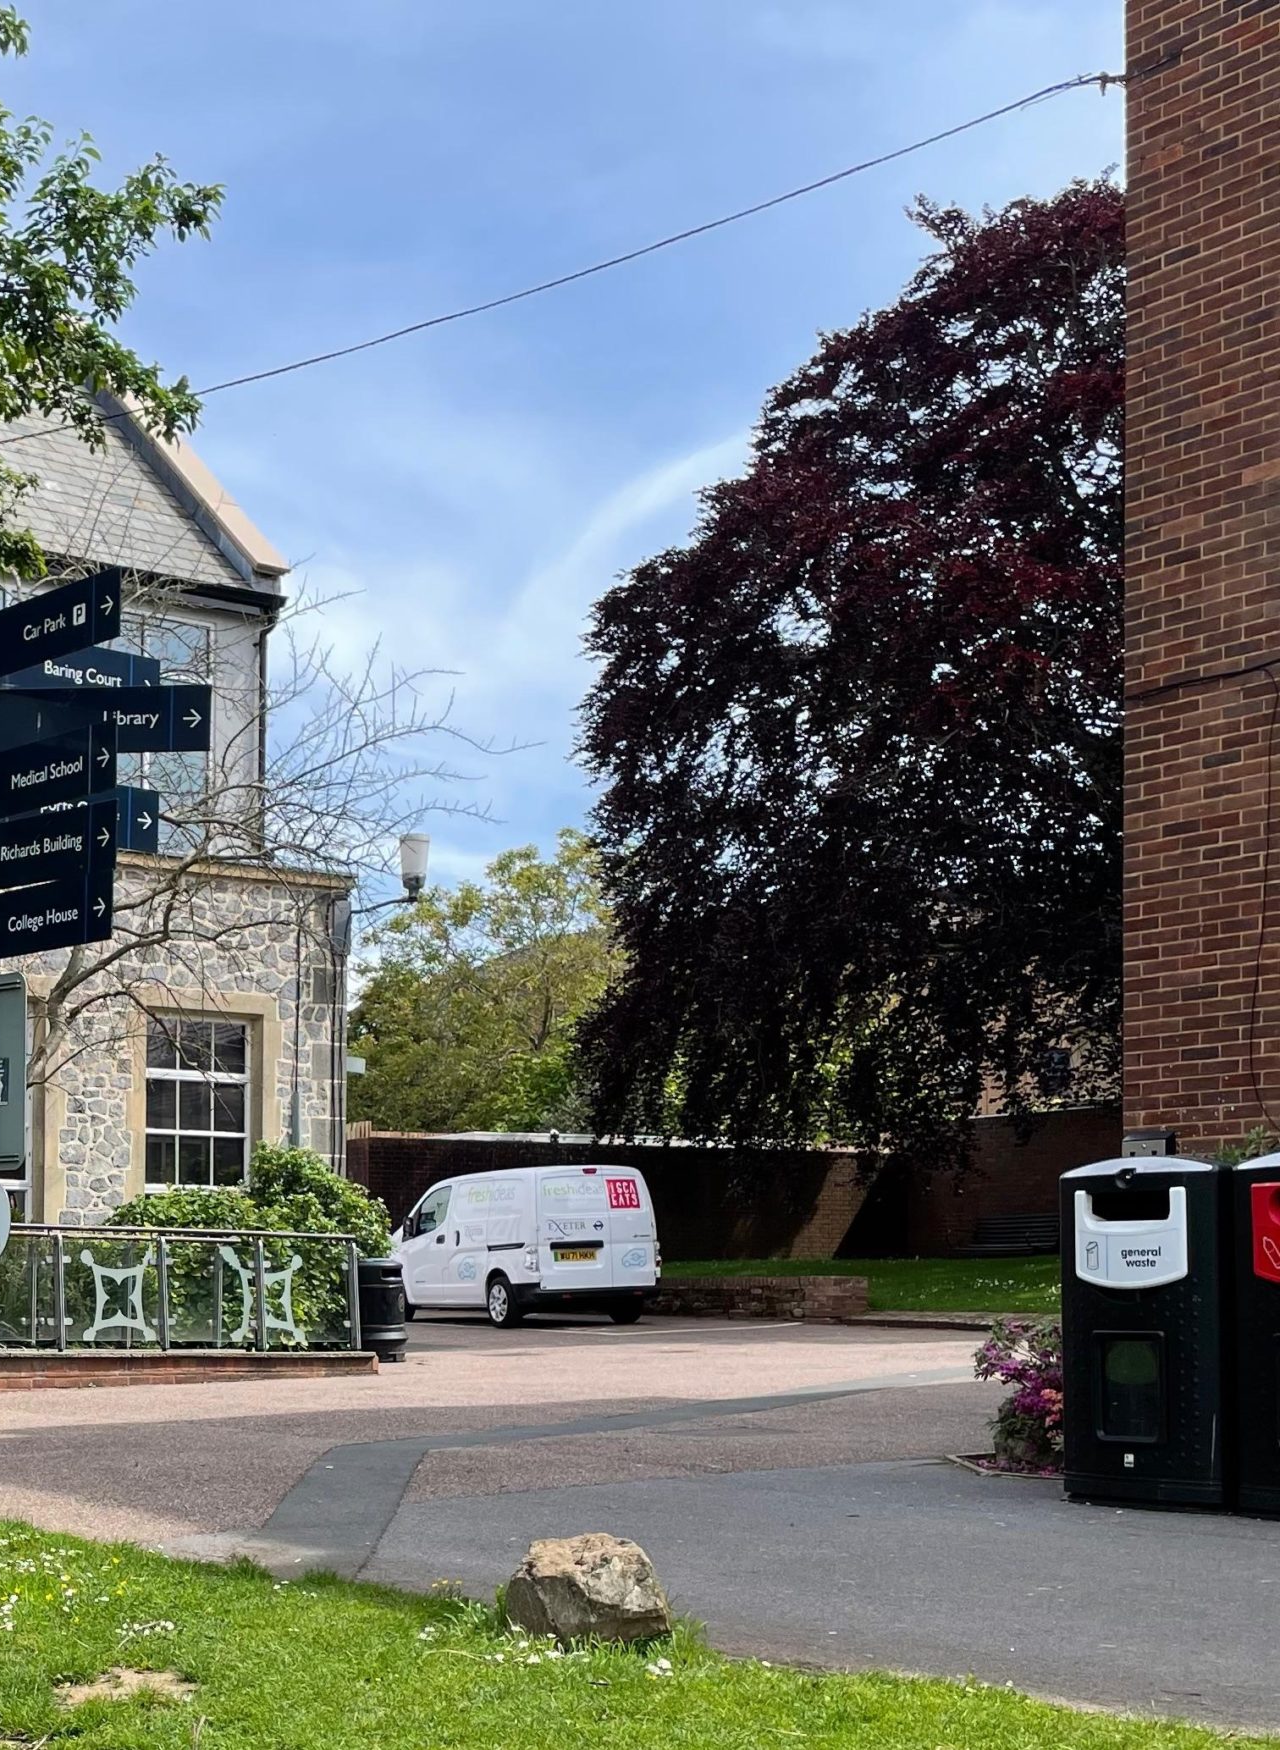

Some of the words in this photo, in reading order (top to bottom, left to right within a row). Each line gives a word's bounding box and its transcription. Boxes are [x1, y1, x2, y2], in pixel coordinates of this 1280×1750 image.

[23, 624, 42, 641] Car
[44, 613, 66, 634] Park
[44, 659, 83, 684] Baring
[86, 668, 122, 687] Court
[11, 766, 48, 790] Medical
[49, 755, 83, 779] School
[0, 840, 41, 862] Richards
[43, 834, 83, 853] Building
[8, 914, 44, 932] College
[46, 908, 79, 925] House
[609, 1181, 636, 1194] ISCA
[611, 1194, 638, 1206] EATS
[547, 1220, 586, 1235] EXETER
[1121, 1246, 1161, 1259] general
[1126, 1258, 1157, 1267] waste
